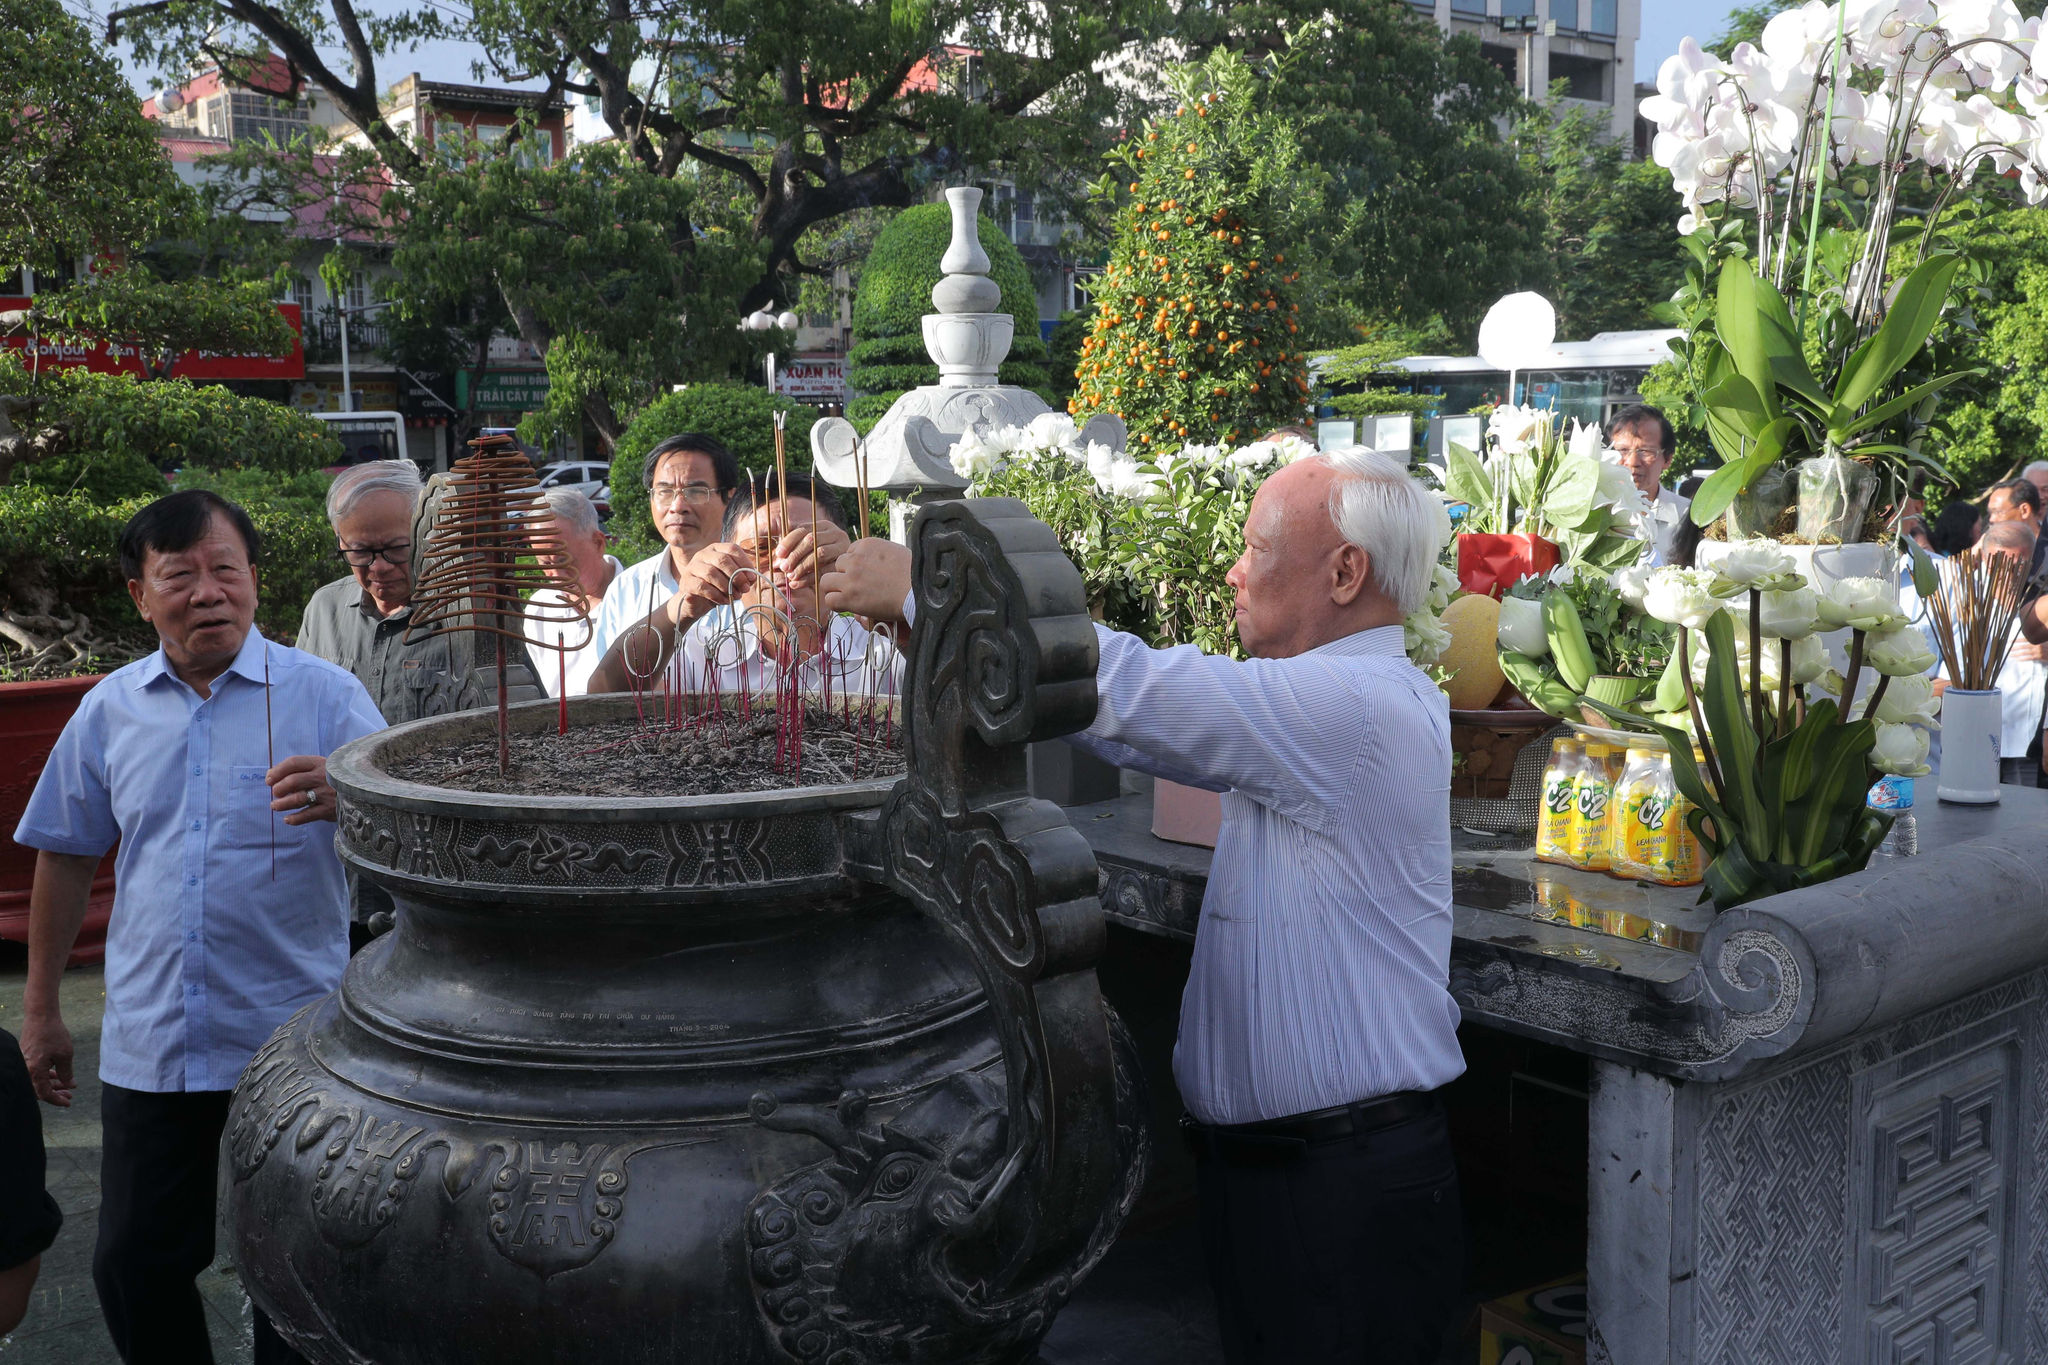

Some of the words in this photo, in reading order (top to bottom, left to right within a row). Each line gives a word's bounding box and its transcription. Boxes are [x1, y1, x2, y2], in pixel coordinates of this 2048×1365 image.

[476, 387, 504, 402] TRÁI
[506, 387, 528, 402] CÂY
[500, 375, 527, 385] MINH
[1546, 782, 1573, 813] C2
[1578, 788, 1608, 820] C2
[1638, 798, 1665, 830] C2
